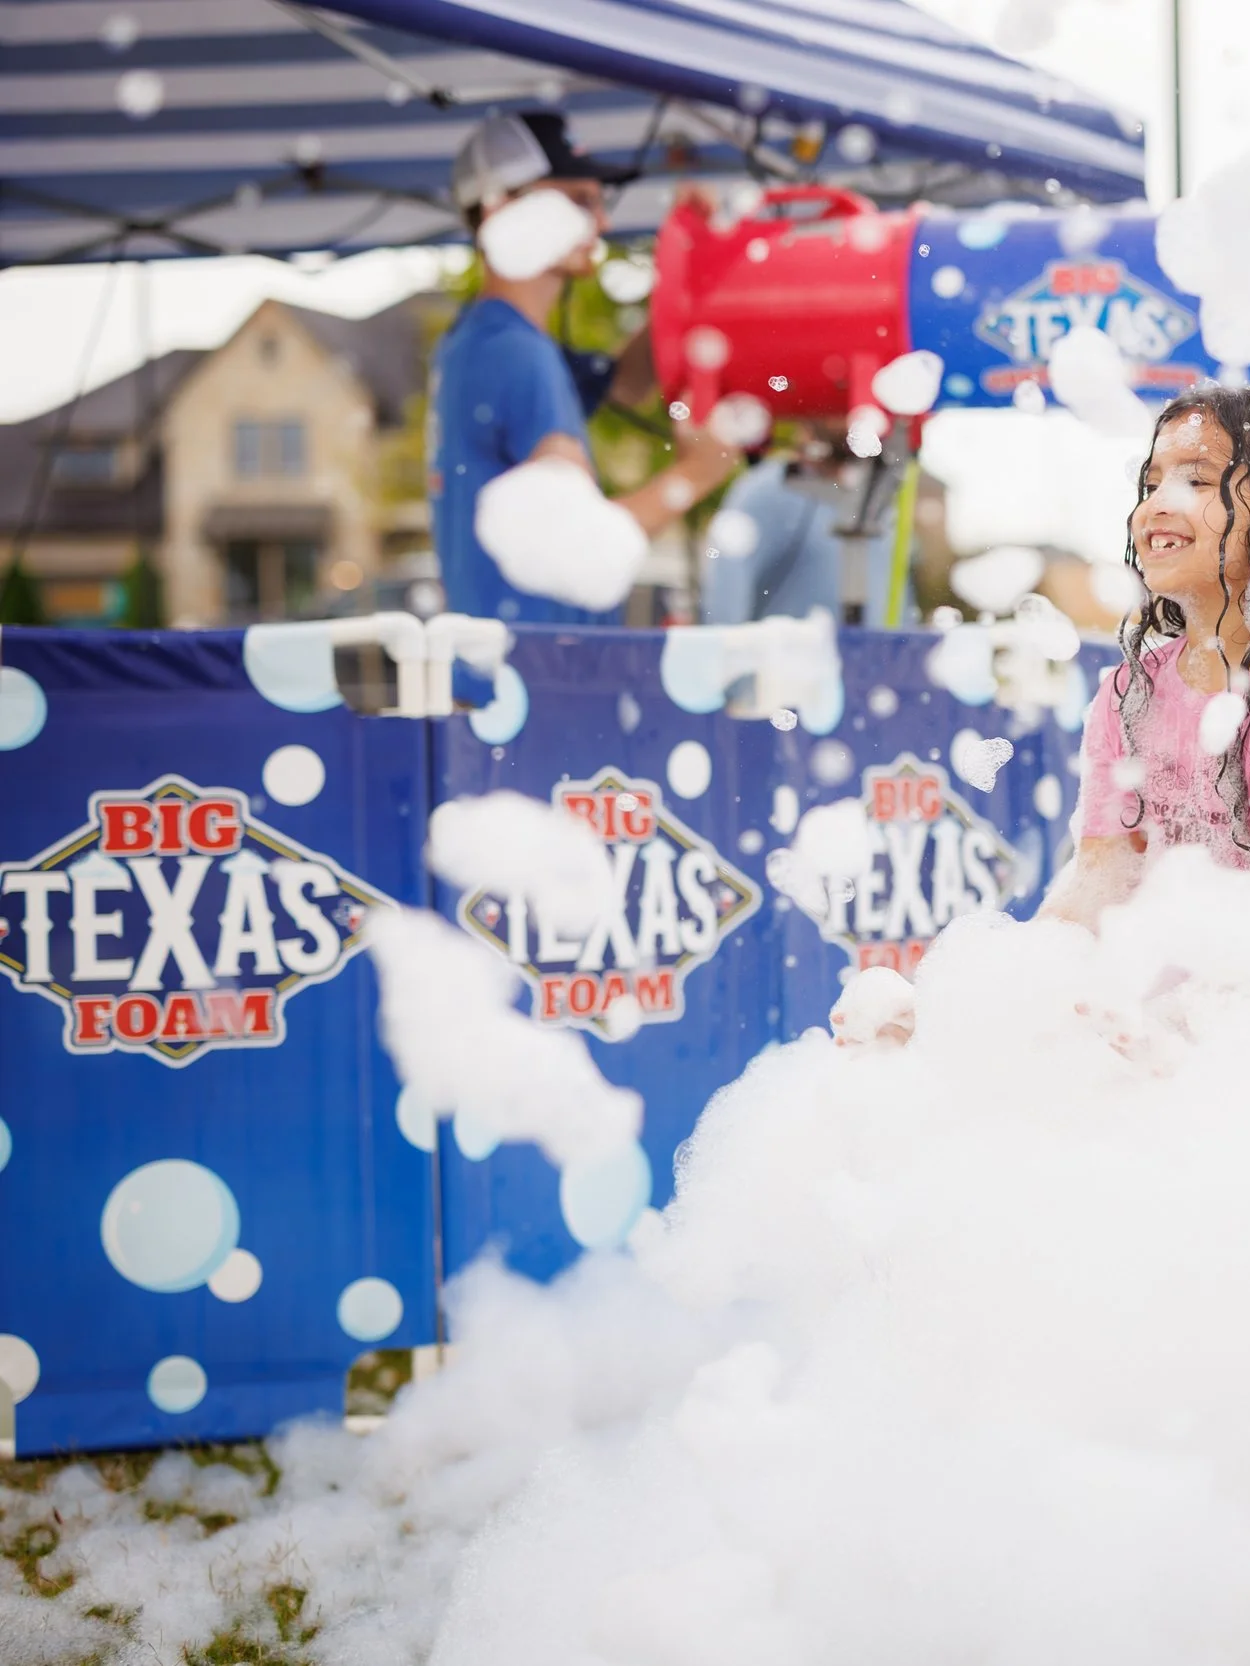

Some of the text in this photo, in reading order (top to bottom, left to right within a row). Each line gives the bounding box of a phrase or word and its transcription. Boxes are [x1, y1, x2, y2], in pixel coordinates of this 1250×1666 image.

[564, 794, 654, 838] BIG
[872, 779, 943, 822] BIG
[102, 802, 239, 852] BIG
[2, 855, 342, 991] TEXAS
[75, 993, 273, 1042] FOAM
[543, 972, 675, 1017] FOAM
